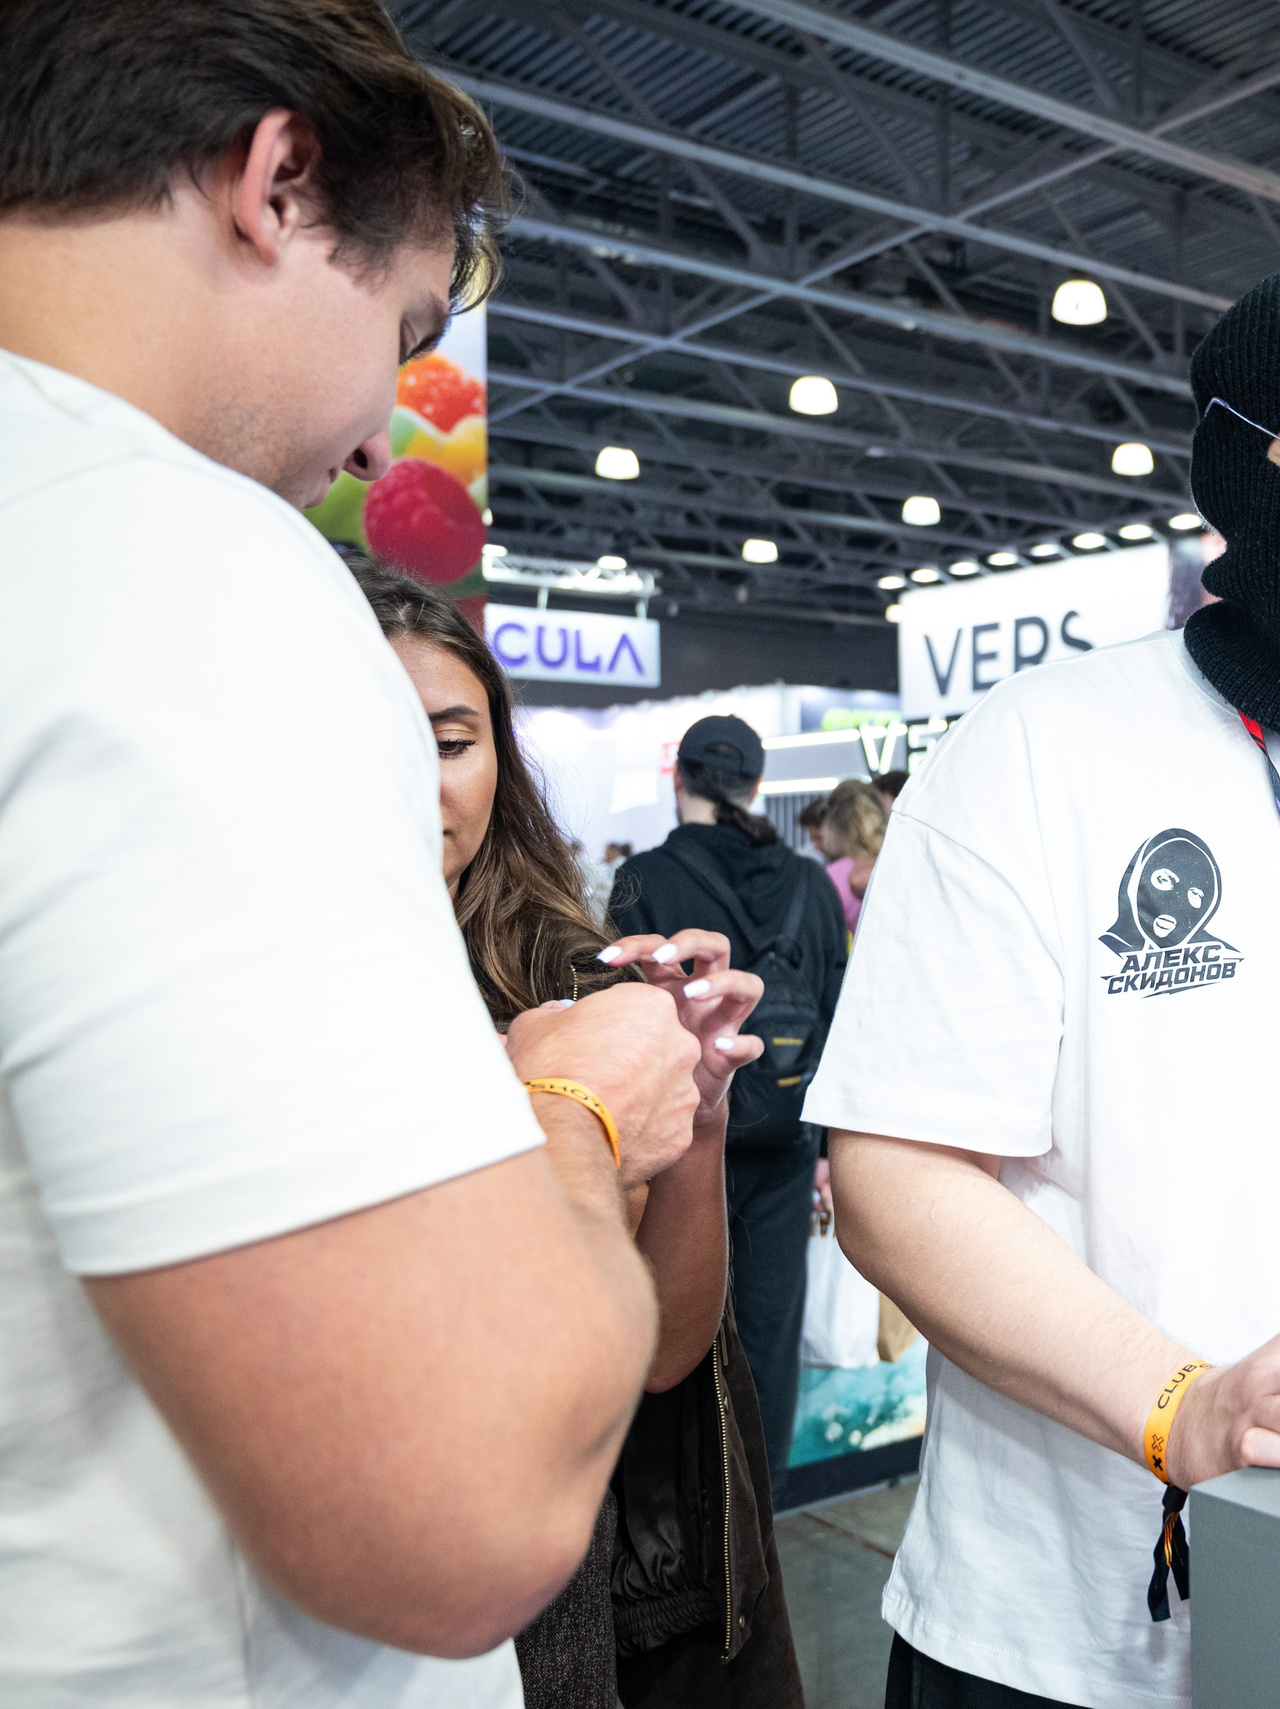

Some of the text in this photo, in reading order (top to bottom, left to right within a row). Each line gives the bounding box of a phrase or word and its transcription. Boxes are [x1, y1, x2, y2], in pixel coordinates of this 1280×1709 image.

[1120, 944, 1222, 974] АЛЕКС
[1107, 962, 1237, 995] СКИДОНОВ
[1157, 1364, 1197, 1410] CLUB
